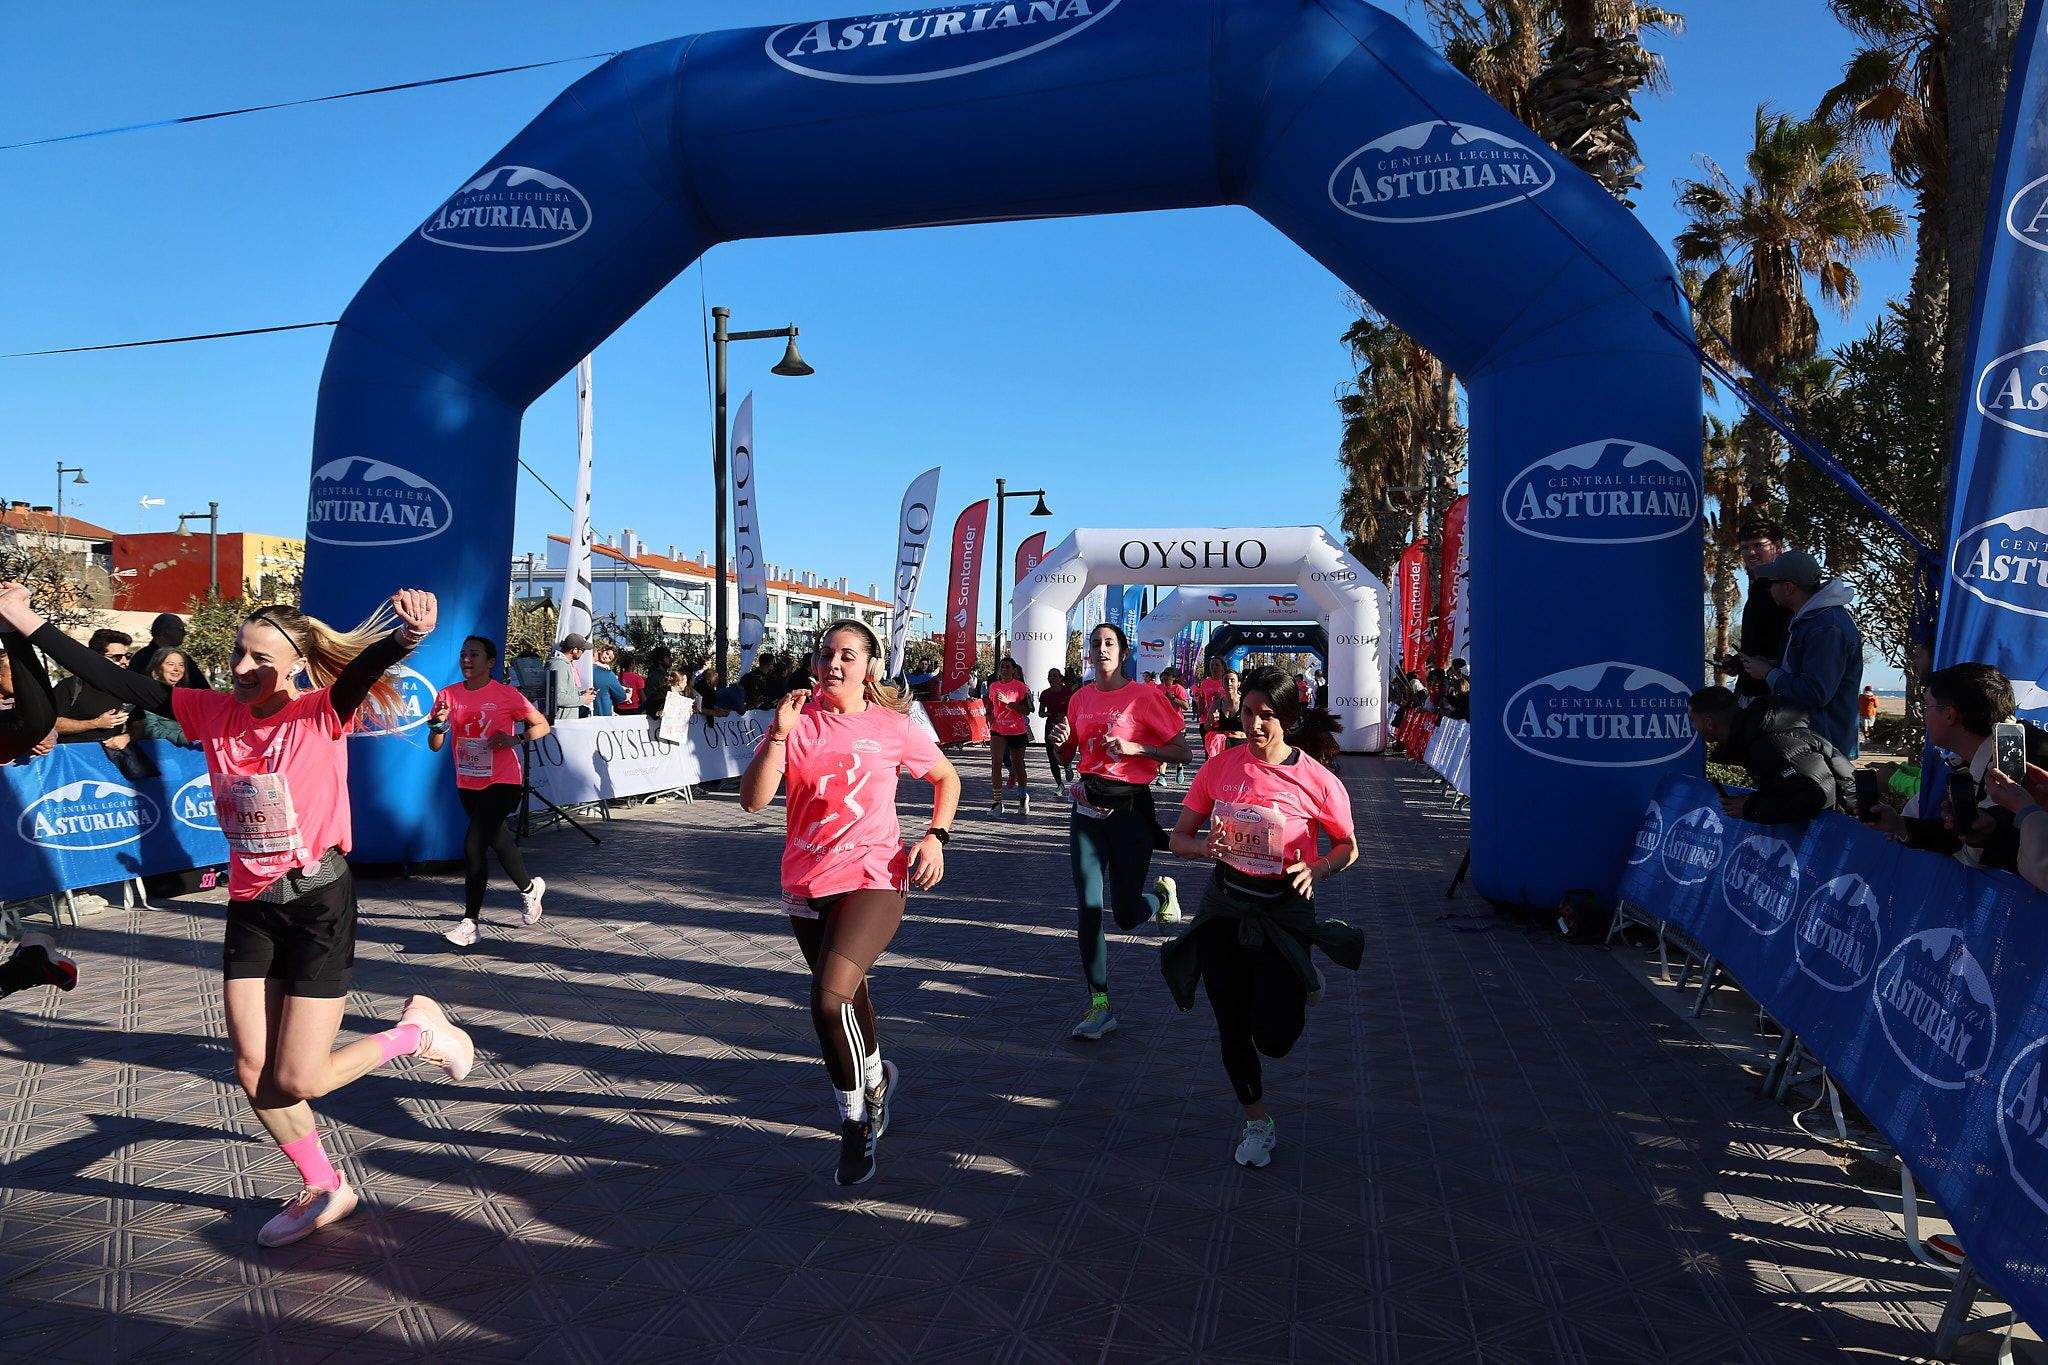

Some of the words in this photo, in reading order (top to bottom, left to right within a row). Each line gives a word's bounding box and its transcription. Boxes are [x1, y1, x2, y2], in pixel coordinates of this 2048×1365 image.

[786, 0, 1092, 57] ASTURIANA
[1377, 151, 1452, 171] CENTRAL
[1459, 150, 1529, 160] LECHERA
[1346, 163, 1542, 206] ASTURIANA
[509, 192, 570, 203] LECHERA
[427, 205, 577, 233] ASTURIANA
[1548, 475, 1622, 488] CENTRAL
[1630, 475, 1687, 487] LECHERA
[317, 486, 361, 496] CENTRAL
[367, 487, 432, 502] LECHERA
[1516, 482, 1691, 521] ASTURIANA
[958, 525, 976, 605] Santander
[1119, 539, 1267, 570] OYSHO
[1034, 573, 1077, 584] OYSHO
[1311, 571, 1357, 581] OYSHO
[1410, 561, 1422, 627] Santander
[1014, 631, 1053, 641] OYSHO
[1336, 634, 1379, 645] OYSHO
[951, 631, 968, 680] Sports
[1335, 696, 1379, 707] OYSHO
[1549, 697, 1623, 708] CENTRAL
[1630, 697, 1688, 708] LECHERA
[1517, 699, 1693, 739] ASTURIANA
[32, 809, 152, 839] ASTURIANA
[236, 811, 267, 824] 016
[1235, 832, 1261, 846] 016
[1881, 955, 1973, 1067] ASTURIAN
